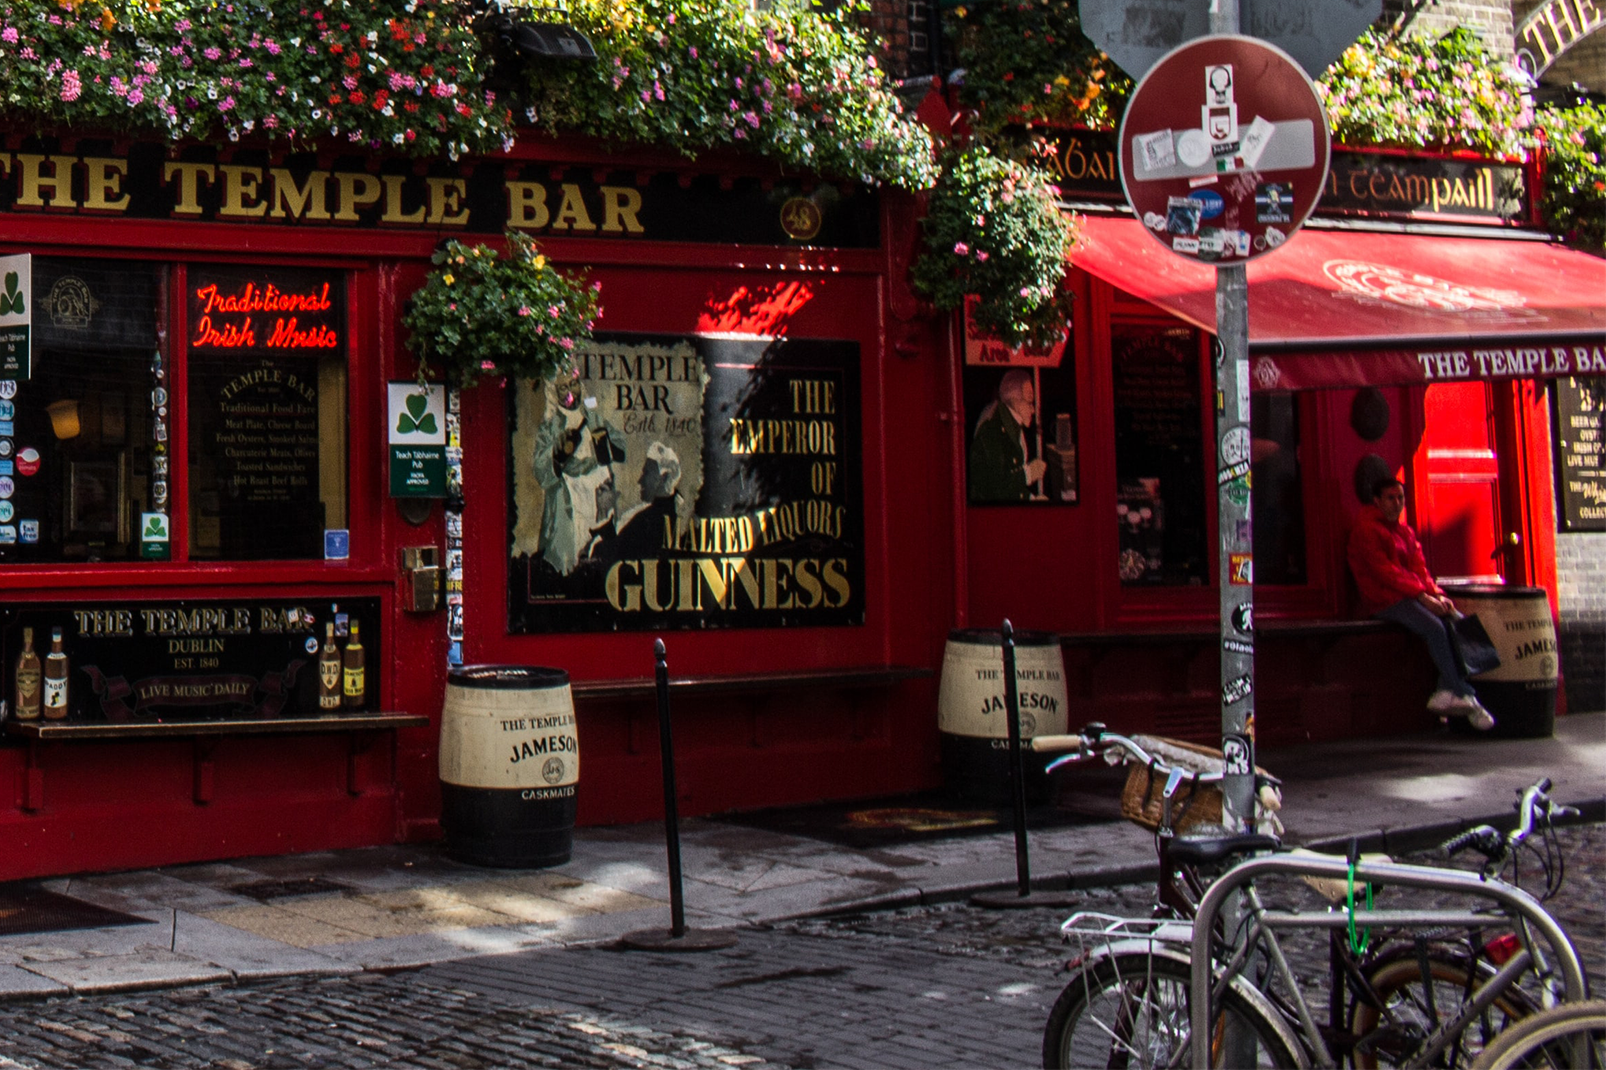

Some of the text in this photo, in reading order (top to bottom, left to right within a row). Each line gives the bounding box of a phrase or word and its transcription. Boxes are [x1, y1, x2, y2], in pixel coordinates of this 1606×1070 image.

[164, 162, 471, 226] TEMPLE
[505, 179, 645, 232] BAR
[197, 281, 331, 314] Traditional
[193, 315, 338, 349] Irish Music
[577, 352, 701, 383] TEMPLE
[1417, 345, 1606, 379] THE TEMPLE BA
[221, 368, 317, 403] TEMPLE BAR
[615, 384, 673, 415] BAR
[789, 379, 835, 415] THE
[220, 401, 316, 413] Traditional Food Fare
[216, 433, 236, 443] Fresh
[268, 433, 295, 444] Smoked
[268, 419, 292, 430] Cheese
[729, 417, 836, 456] EMPEROR
[236, 461, 264, 471] Toasted
[395, 450, 412, 460] Teach
[412, 460, 423, 469] Pub
[249, 475, 270, 485] Roast
[811, 461, 836, 496] OF
[661, 498, 846, 554] MALTED LIQUORS
[604, 556, 851, 613] GUINNESS
[74, 605, 313, 636] THE TEMPLE BAR
[168, 638, 225, 655] DUBLIN
[174, 656, 220, 669] EST. 1840
[976, 669, 999, 681] THE
[140, 682, 251, 700] LIVE MUSIC DAILY
[500, 719, 526, 732] THE
[529, 715, 568, 731] TEMPLE
[510, 734, 577, 764] JAMESON
[521, 786, 576, 801] CASKMATES
